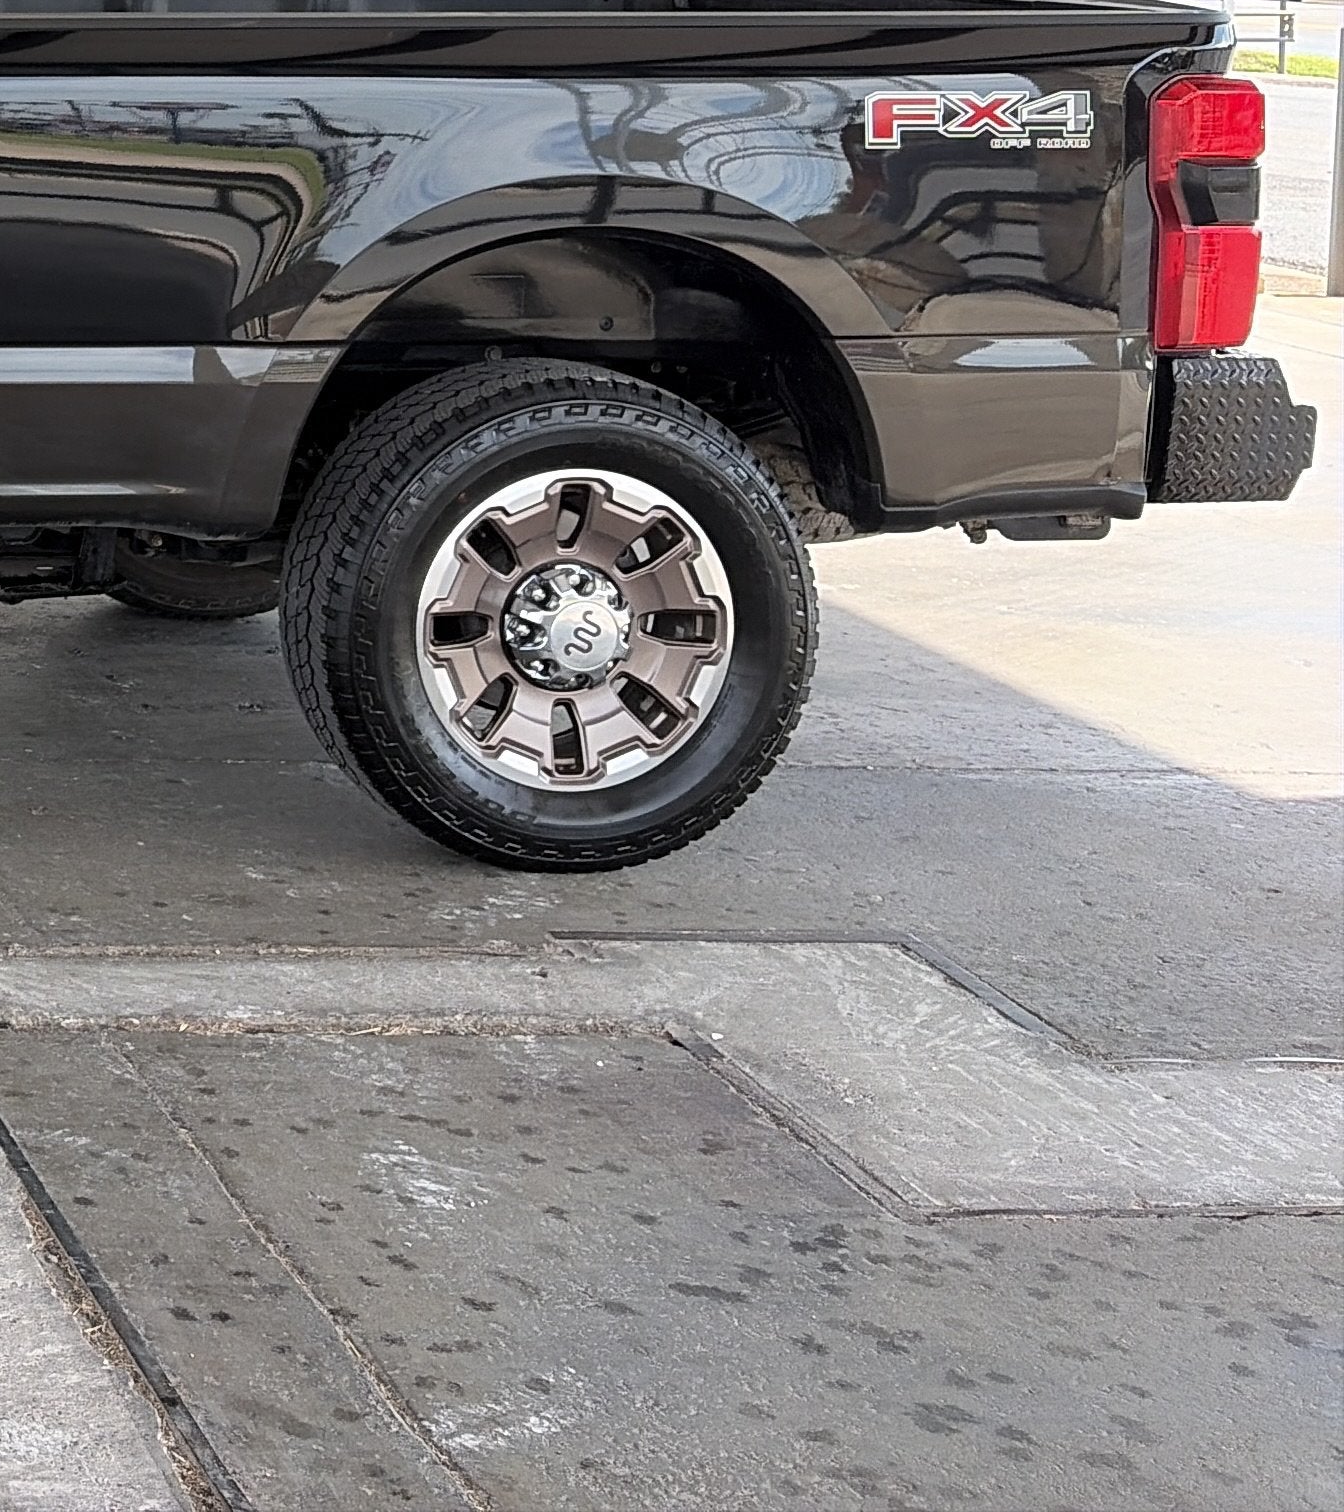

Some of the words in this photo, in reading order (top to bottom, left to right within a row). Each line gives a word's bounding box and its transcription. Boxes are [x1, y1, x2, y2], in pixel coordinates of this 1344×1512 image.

[865, 91, 1094, 149] FX4
[990, 138, 1031, 149] OFF
[1036, 138, 1091, 149] ROAD
